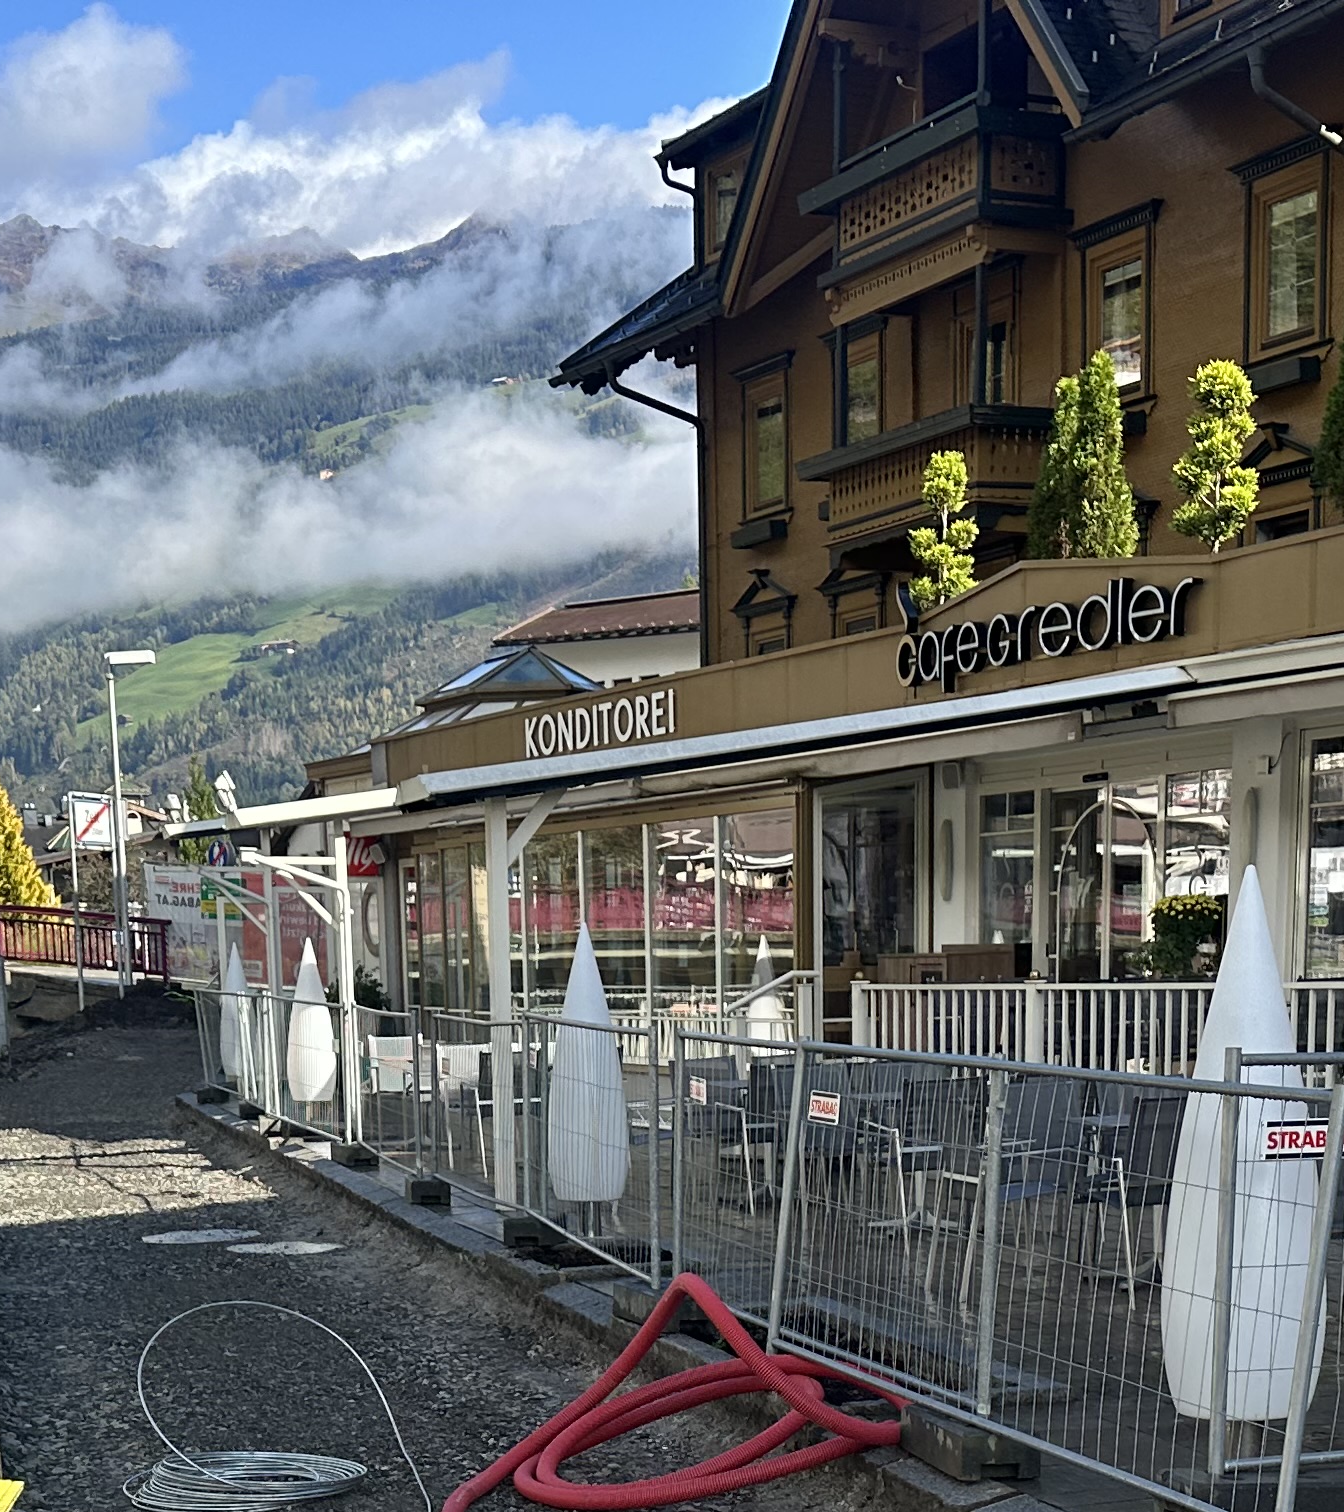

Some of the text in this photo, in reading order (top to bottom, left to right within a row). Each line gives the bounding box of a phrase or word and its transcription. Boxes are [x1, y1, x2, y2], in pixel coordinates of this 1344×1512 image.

[524, 688, 676, 759] KONDITOREI
[346, 838, 373, 874] lly
[810, 1099, 838, 1117] STRABAG
